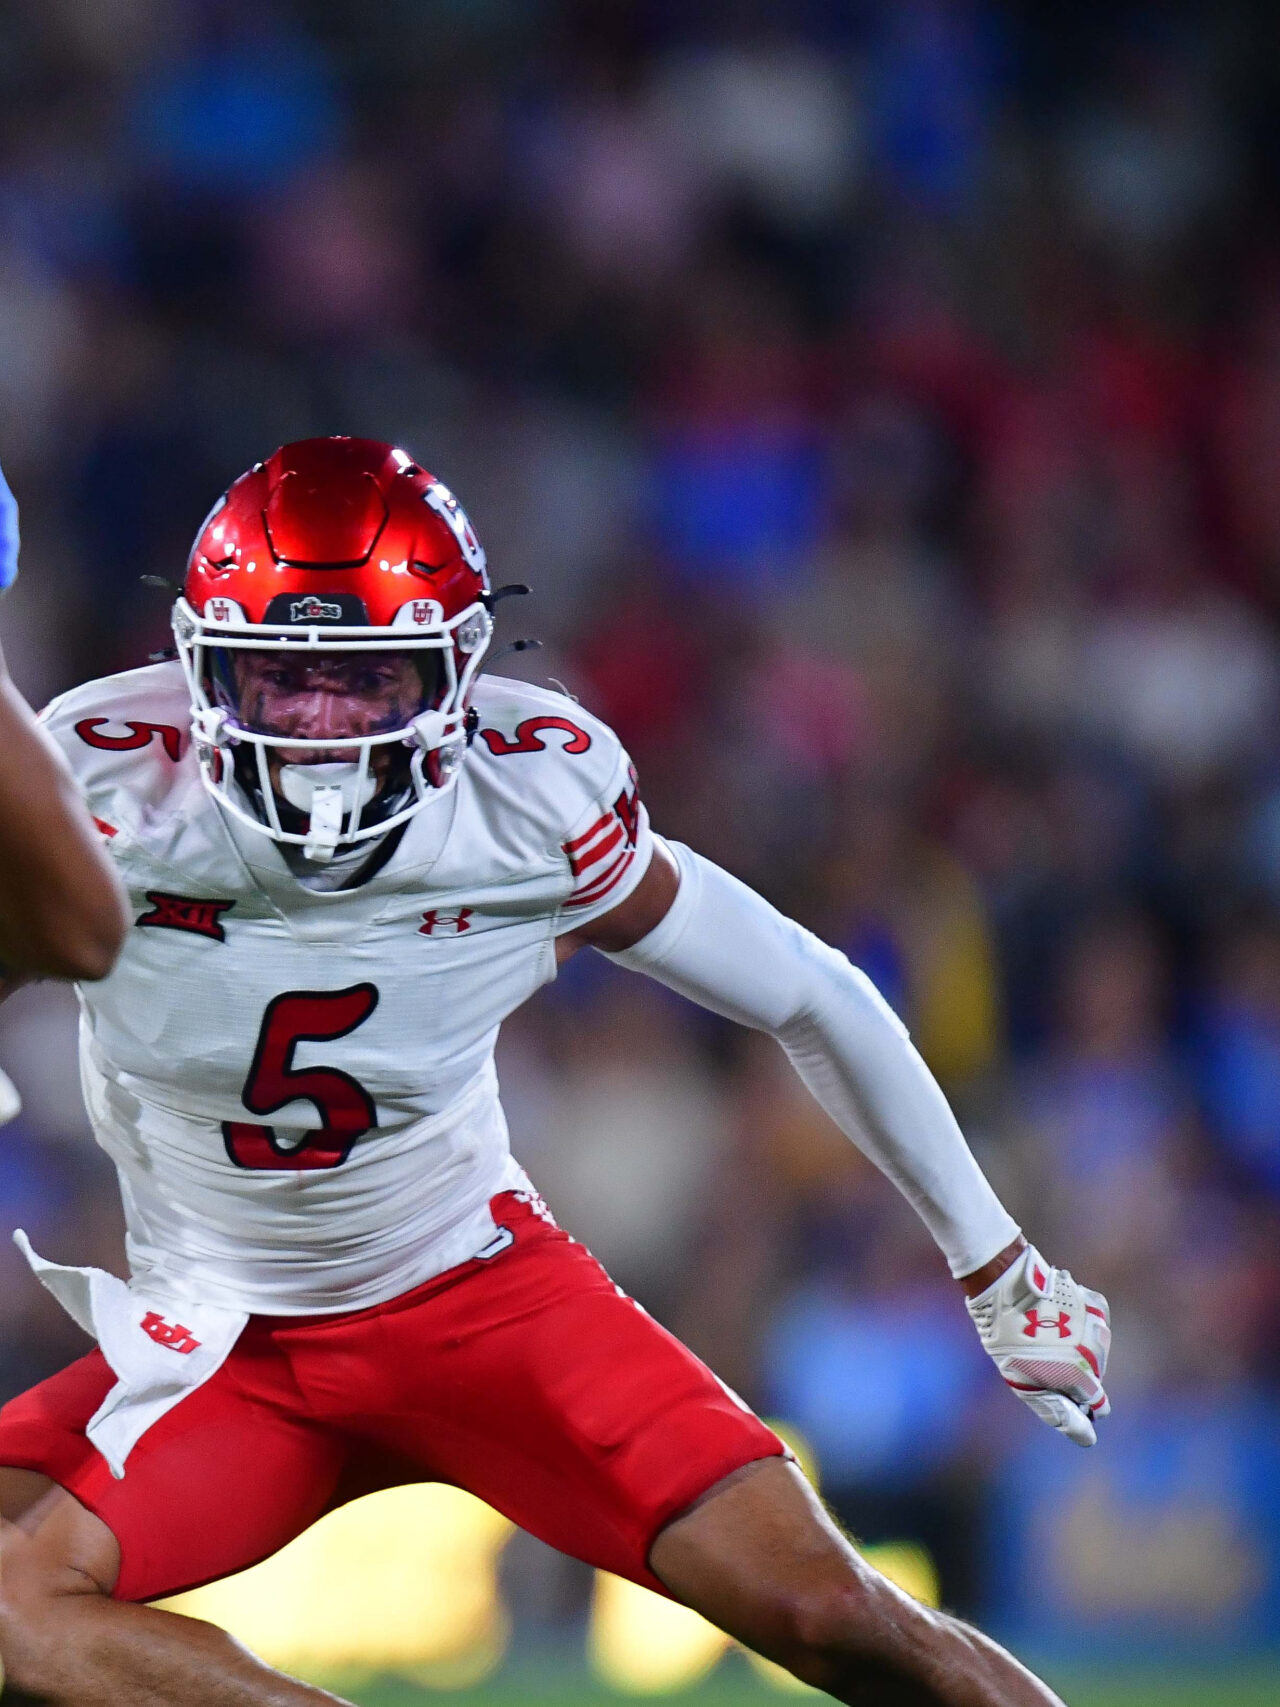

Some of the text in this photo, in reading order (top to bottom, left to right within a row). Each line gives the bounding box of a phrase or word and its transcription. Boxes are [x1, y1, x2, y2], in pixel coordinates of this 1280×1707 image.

[74, 717, 180, 762] 5
[480, 716, 591, 756] 5
[221, 982, 379, 1171] 5
